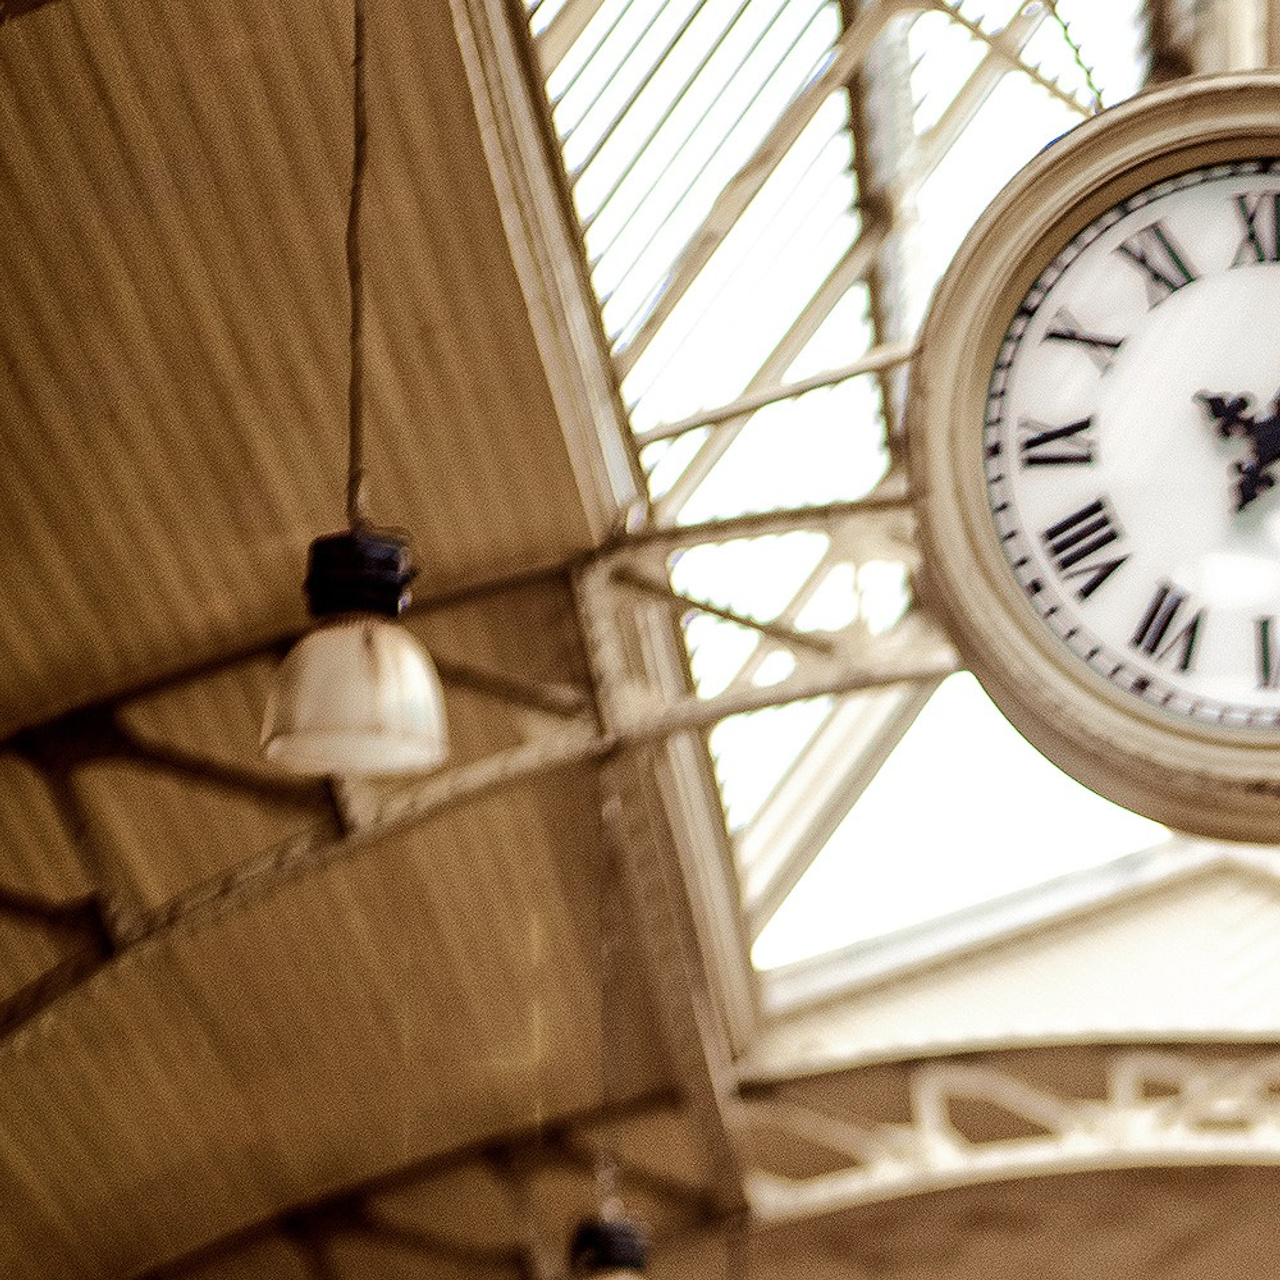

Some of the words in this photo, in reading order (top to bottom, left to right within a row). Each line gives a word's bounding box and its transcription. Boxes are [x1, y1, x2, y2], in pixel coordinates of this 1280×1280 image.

[1116, 222, 1200, 311] XI
[1043, 307, 1125, 375] X
[1018, 415, 1096, 468] IX
[1042, 496, 1129, 601] VIII
[1130, 583, 1207, 675] VII
